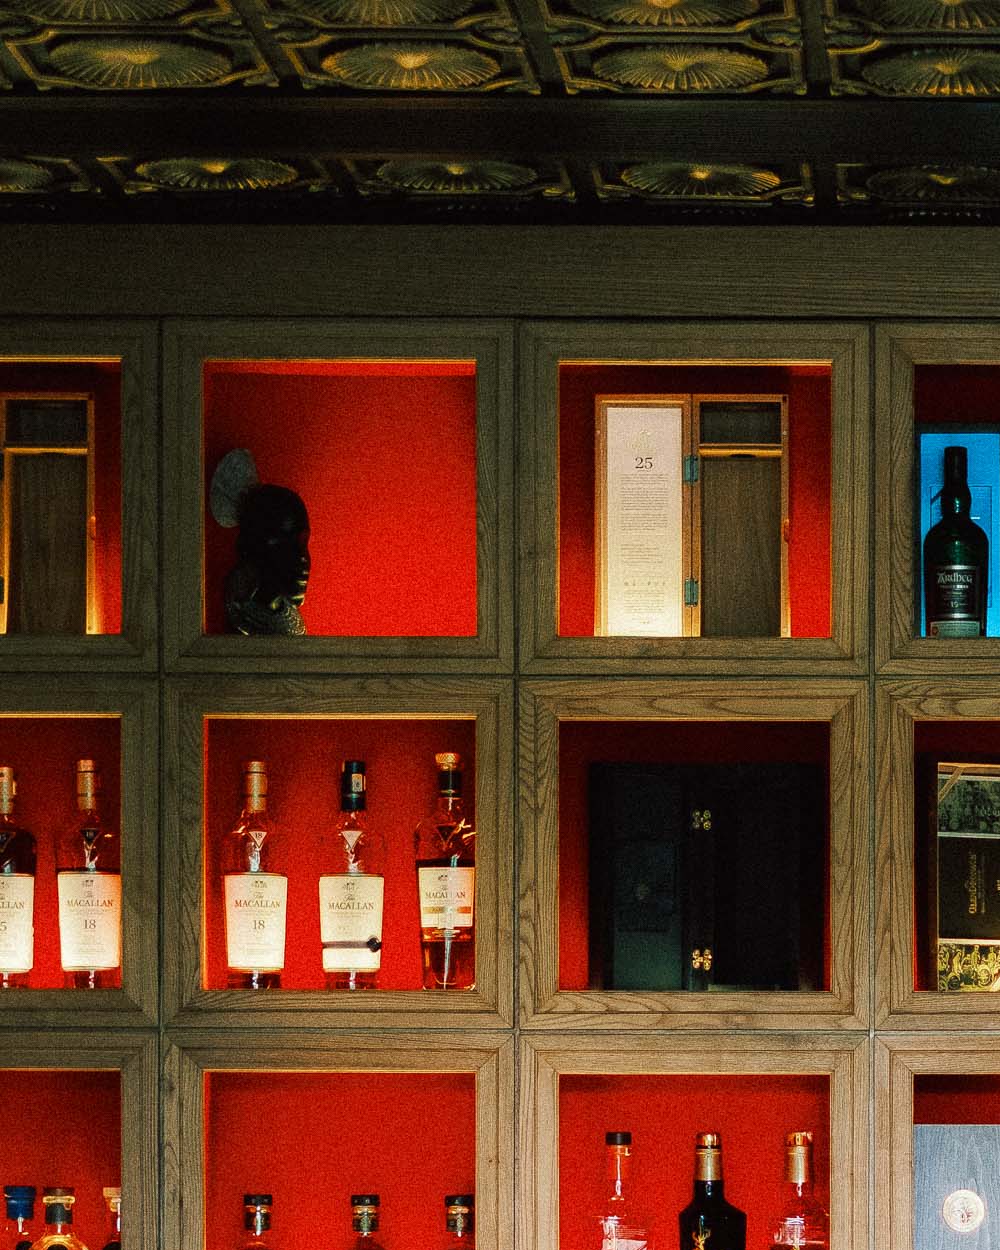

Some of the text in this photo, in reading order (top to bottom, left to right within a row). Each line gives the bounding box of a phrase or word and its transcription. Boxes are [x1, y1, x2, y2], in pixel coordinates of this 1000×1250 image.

[635, 457, 653, 469] 25
[67, 899, 114, 908] MACALLAN
[234, 899, 280, 908] MACALLAN
[328, 902, 374, 910] MACALLAN
[84, 919, 96, 929] 18
[253, 920, 265, 930] 18
